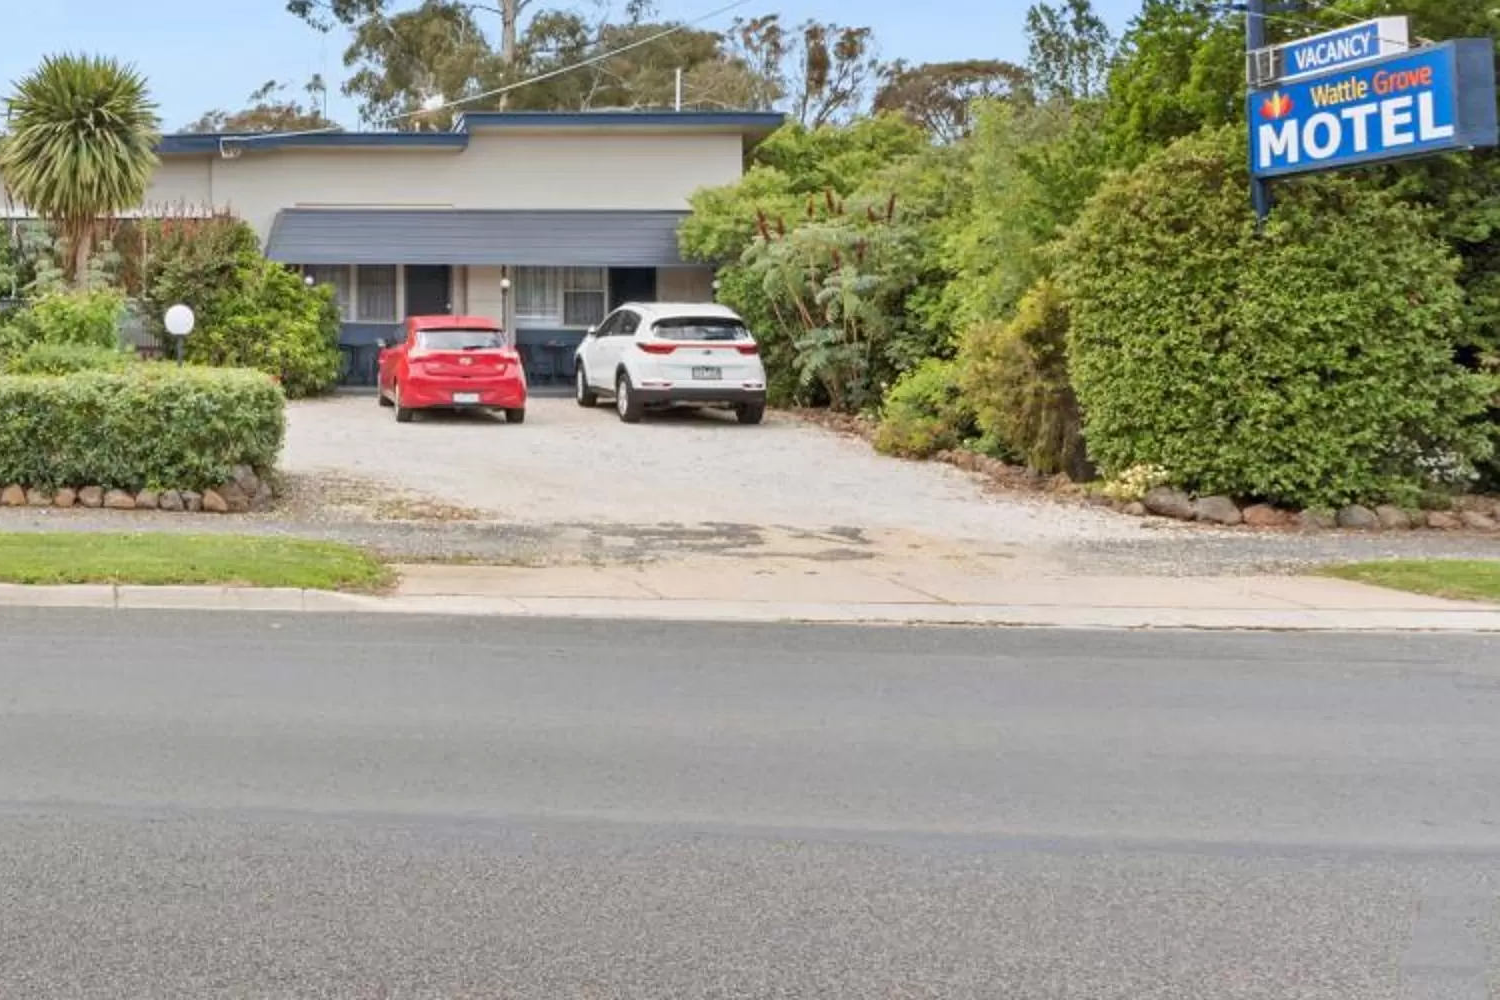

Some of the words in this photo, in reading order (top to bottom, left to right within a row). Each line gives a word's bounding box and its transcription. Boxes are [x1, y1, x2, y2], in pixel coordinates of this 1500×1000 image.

[1295, 31, 1370, 70] VACANCY
[1310, 76, 1367, 108] Wattle
[1373, 65, 1432, 95] Grove
[1259, 91, 1454, 168] MOTEL
